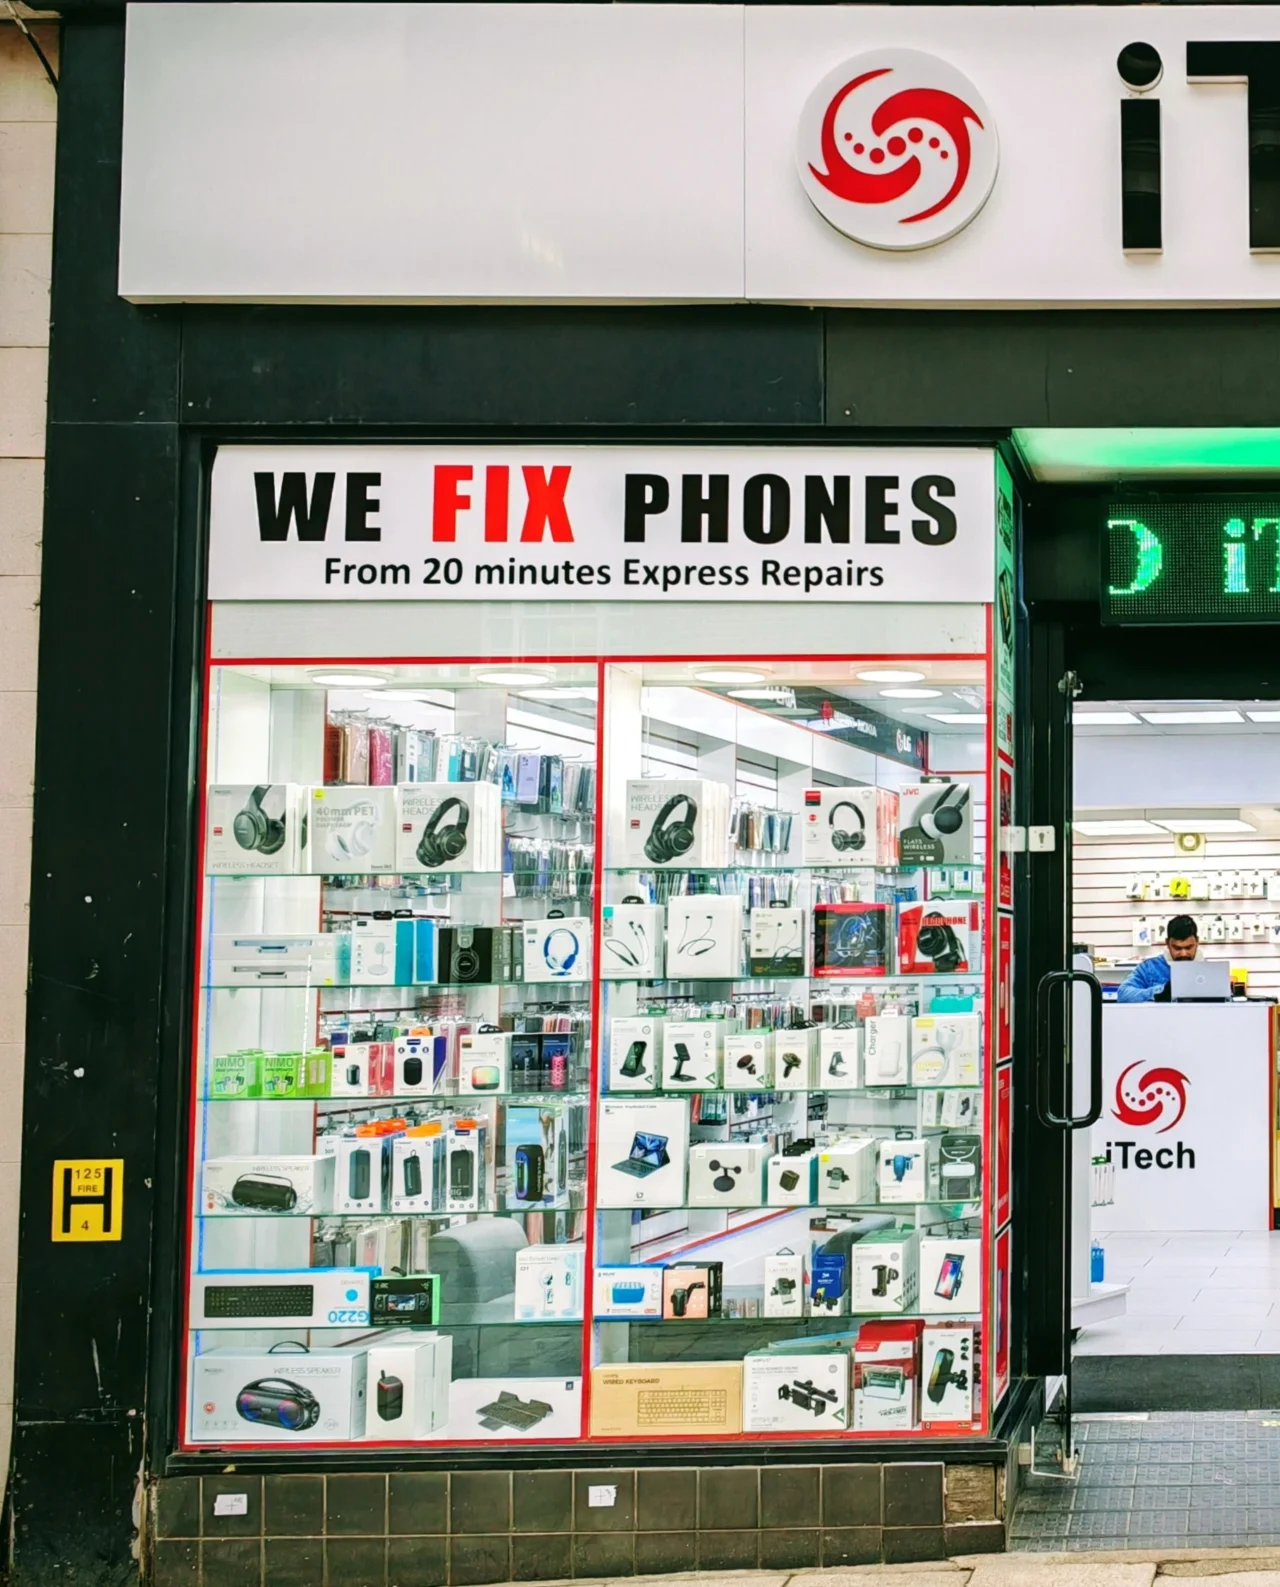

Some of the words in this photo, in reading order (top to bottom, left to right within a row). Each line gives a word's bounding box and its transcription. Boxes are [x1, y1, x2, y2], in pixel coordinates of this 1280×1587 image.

[253, 471, 382, 543] WE
[433, 464, 575, 544] FIX
[623, 473, 957, 546] PHONES
[325, 557, 411, 585] From
[422, 557, 463, 585] 20
[475, 557, 611, 585] minutes
[623, 558, 749, 592] Express
[761, 558, 885, 592] Repairs
[903, 788, 919, 796] JVC
[403, 807, 434, 816] HEADS
[631, 804, 662, 812] HEADS
[868, 1021, 878, 1055] Charger
[215, 1057, 245, 1067] NIMO
[265, 1057, 294, 1067] NIMO
[1106, 1141, 1195, 1169] iTech
[77, 1184, 98, 1193] FIRE
[62, 1167, 113, 1234] H
[80, 1220, 90, 1231] 4
[328, 1310, 369, 1324] G220
[625, 1377, 660, 1385] KEYBOARD
